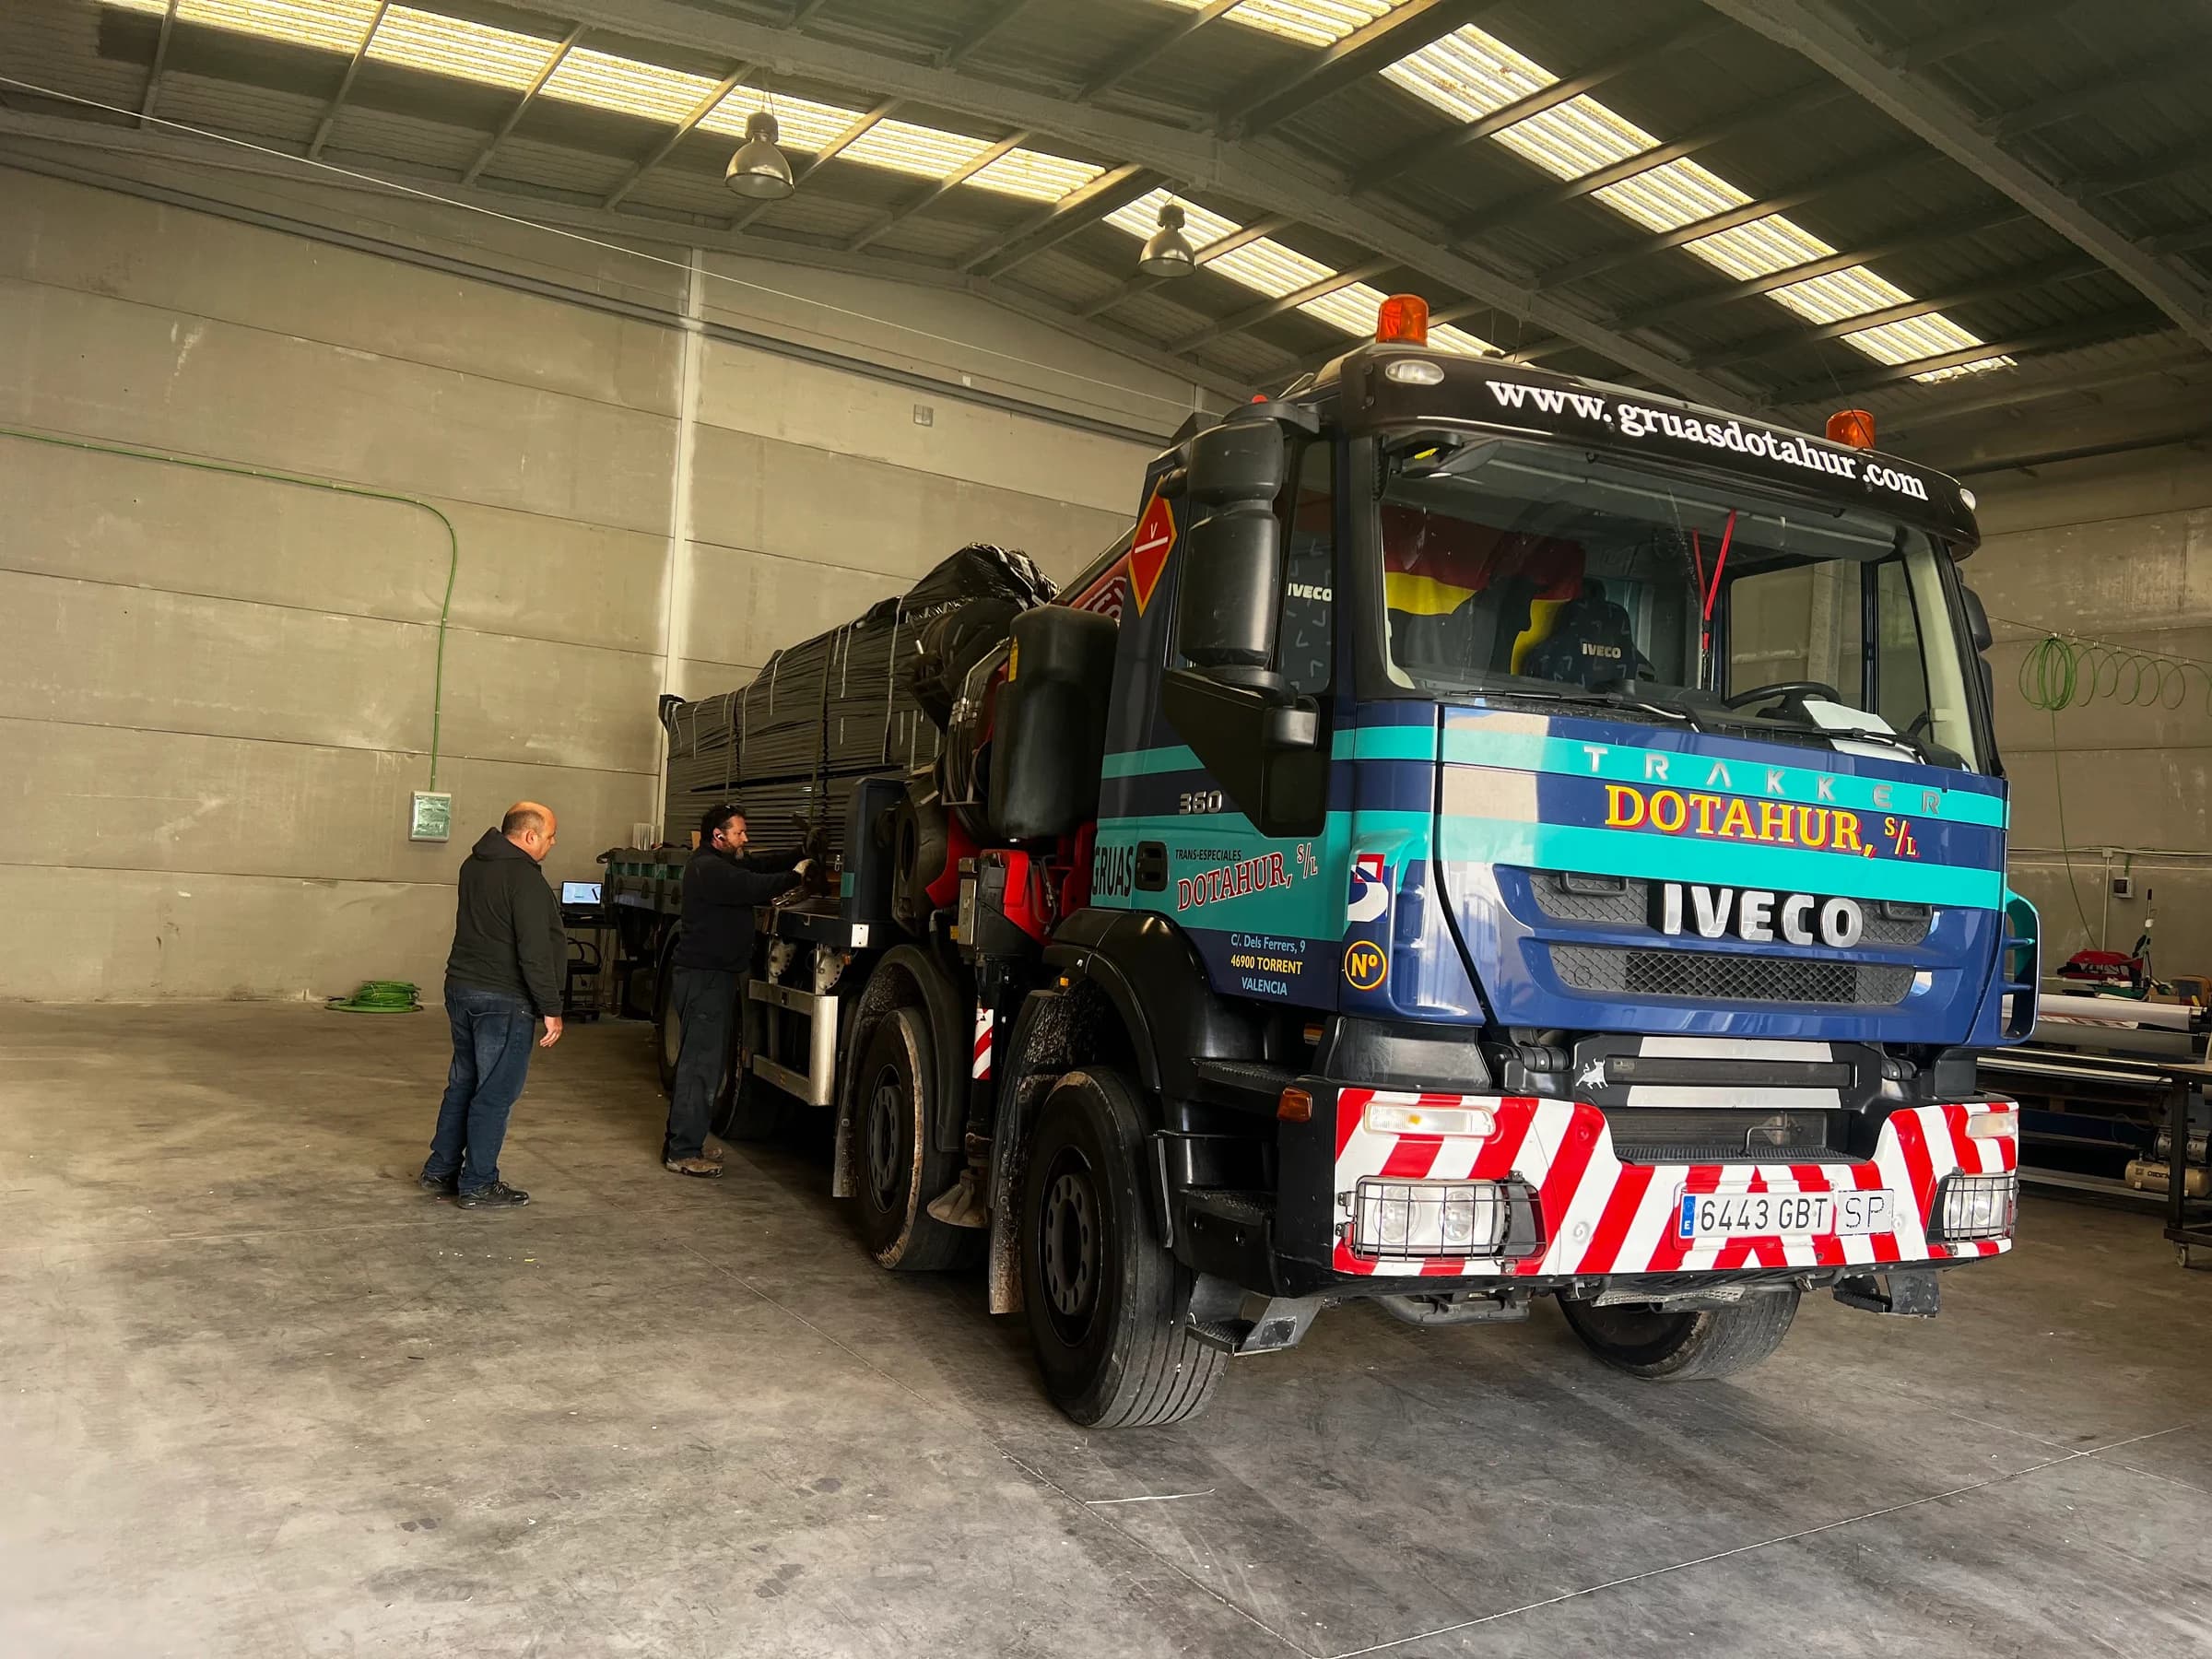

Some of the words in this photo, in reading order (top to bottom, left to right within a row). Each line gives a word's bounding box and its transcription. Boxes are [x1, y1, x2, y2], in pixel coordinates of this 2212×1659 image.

[1485, 380, 1929, 502] www.gruasdotahur.com
[1288, 582, 1333, 602] IVECO
[1582, 642, 1622, 659] IVECO
[1583, 745, 1943, 815] TRAKKER
[1179, 790, 1223, 814] 360
[1604, 783, 1877, 859] DOTAHUR,
[1884, 816, 1919, 857] S/L
[1091, 845, 1134, 897] GRUAS
[1175, 849, 1241, 862] TRANS-ESPECIALES
[1177, 851, 1292, 912] DOTAHUR,
[1297, 842, 1318, 878] S/L
[1662, 882, 1864, 948] IVECO
[1243, 935, 1262, 949] Dels
[1264, 936, 1298, 954] Ferrers,
[1300, 939, 1306, 953] 9
[1230, 954, 1255, 970] 46900
[1257, 957, 1303, 975] TORRENT
[1241, 976, 1288, 996] VALENCIA
[1684, 1220, 1691, 1230] E
[1700, 1199, 1770, 1231] 6443
[1778, 1197, 1829, 1230] GBT
[1844, 1195, 1886, 1230] SP
